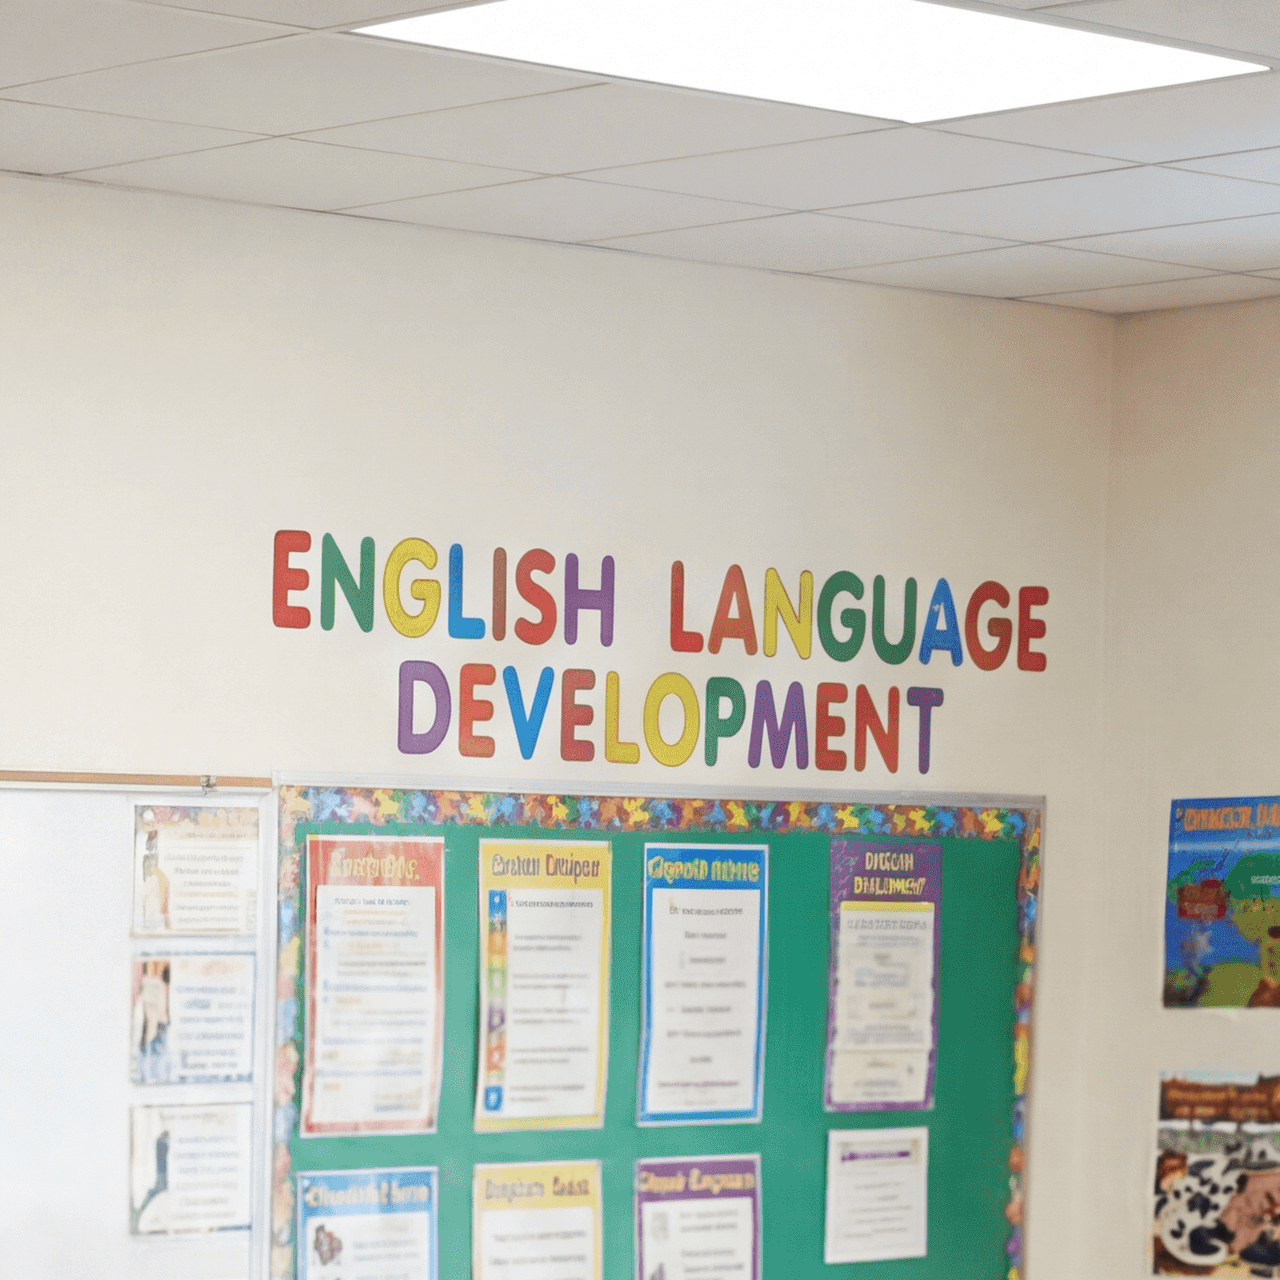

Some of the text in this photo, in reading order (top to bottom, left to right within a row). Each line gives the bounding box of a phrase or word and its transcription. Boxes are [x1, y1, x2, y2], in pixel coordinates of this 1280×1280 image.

[271, 529, 1050, 672] ENGLISH LANGUAGE
[397, 659, 945, 774] DEVELOPMENT
